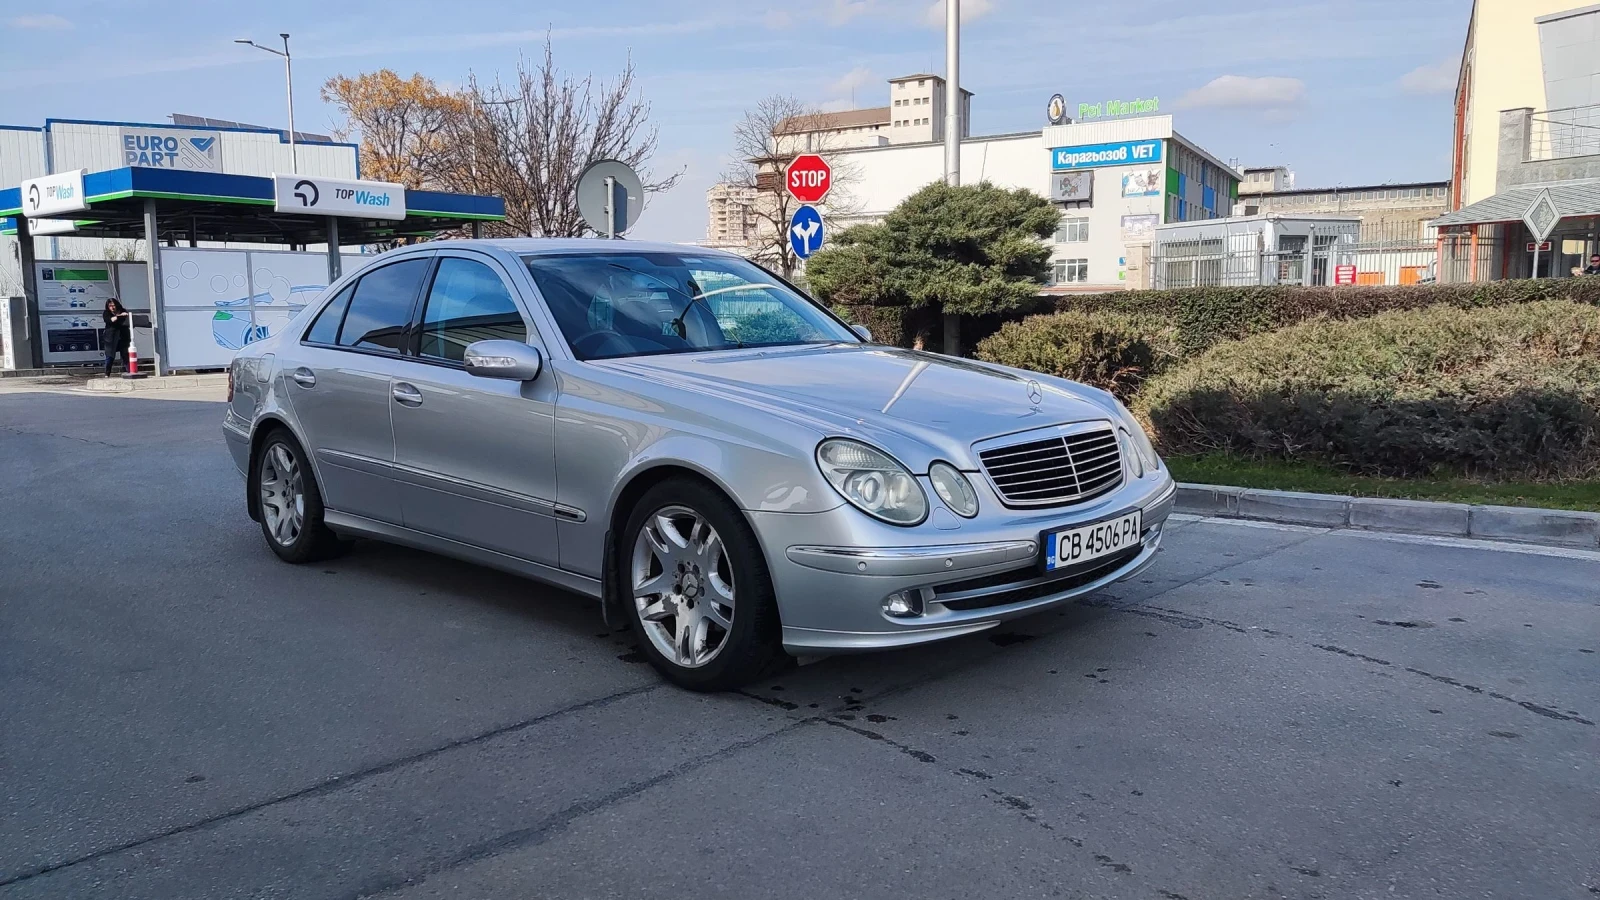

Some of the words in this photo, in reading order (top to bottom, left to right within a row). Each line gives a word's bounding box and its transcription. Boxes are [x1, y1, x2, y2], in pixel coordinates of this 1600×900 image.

[1079, 103, 1102, 118] Pet
[1107, 96, 1159, 116] Market
[124, 135, 178, 151] EURO
[126, 152, 178, 167] PART
[1058, 147, 1127, 166] Карагьозов
[1132, 144, 1155, 159] VET
[791, 170, 826, 187] STOP
[1060, 533, 1081, 561] CB
[1086, 522, 1120, 555] 4506
